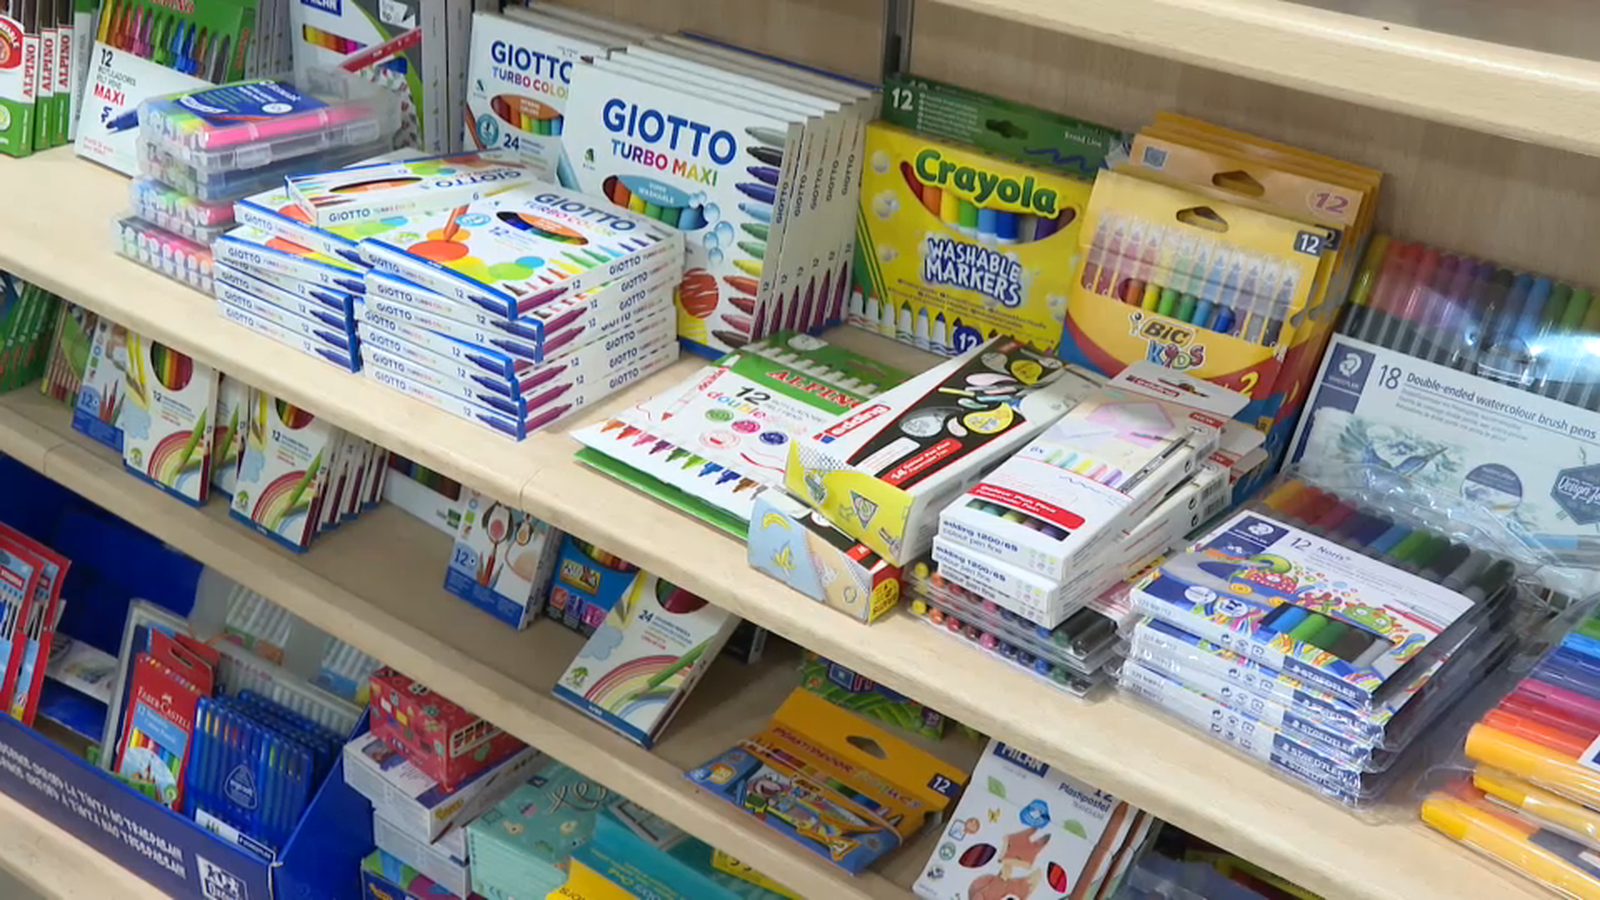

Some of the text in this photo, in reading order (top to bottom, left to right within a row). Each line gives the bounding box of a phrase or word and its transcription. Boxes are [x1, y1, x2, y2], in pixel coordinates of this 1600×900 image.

[42, 38, 54, 92] ALPINO
[59, 34, 71, 88] ALPINO
[101, 48, 114, 68] 12
[23, 44, 36, 98] ALPINO
[492, 65, 569, 99] TURBO COLO
[94, 82, 126, 107] MAXI
[892, 88, 915, 112] 12
[503, 133, 520, 150] 24
[602, 98, 737, 166] GIOTTO
[611, 138, 718, 187] TURBO MAXI
[914, 148, 1059, 217] Crayola
[534, 193, 636, 231] GIOTTO
[1315, 192, 1349, 215] 12
[329, 208, 371, 223] GIOTTO
[1300, 233, 1320, 254] 12
[228, 246, 261, 265] GIOTTO
[369, 253, 400, 273] GIOTTO
[610, 255, 641, 276] GIOTTO
[926, 236, 1022, 286] WASHABLE
[621, 271, 648, 292] GIOTTO
[924, 254, 1022, 309] MARKERS
[377, 284, 413, 303] GIOTTO
[619, 290, 646, 311] GIOTTO
[365, 311, 396, 331] GIOTTO
[376, 302, 413, 321] GIOTTO
[369, 332, 401, 352] GIOTTO
[605, 330, 636, 351] GIOTTO
[373, 352, 405, 372] GIOTTO
[609, 347, 638, 368] GIOTTO
[374, 370, 407, 391] GIOTTO
[609, 367, 639, 389] GIOTTO
[82, 390, 95, 406] 12
[153, 390, 162, 403] 12
[735, 386, 771, 406] 12
[1378, 364, 1402, 390] 18
[1406, 372, 1476, 402] Double-ended
[1475, 394, 1537, 422] watercolour
[1537, 412, 1568, 432] brush
[1568, 423, 1597, 444] pens
[832, 406, 888, 435] edding
[272, 429, 282, 442] 12
[943, 519, 975, 538] edding
[942, 527, 969, 544] colour
[970, 538, 987, 550] pen
[986, 542, 1004, 556] fine
[1291, 537, 1313, 552] 12
[455, 549, 469, 567] 12
[936, 545, 967, 563] edding
[638, 609, 655, 623] 24
[1302, 670, 1357, 699] STAEDTLER
[1002, 744, 1043, 774] MILAN
[932, 776, 952, 796] 12
